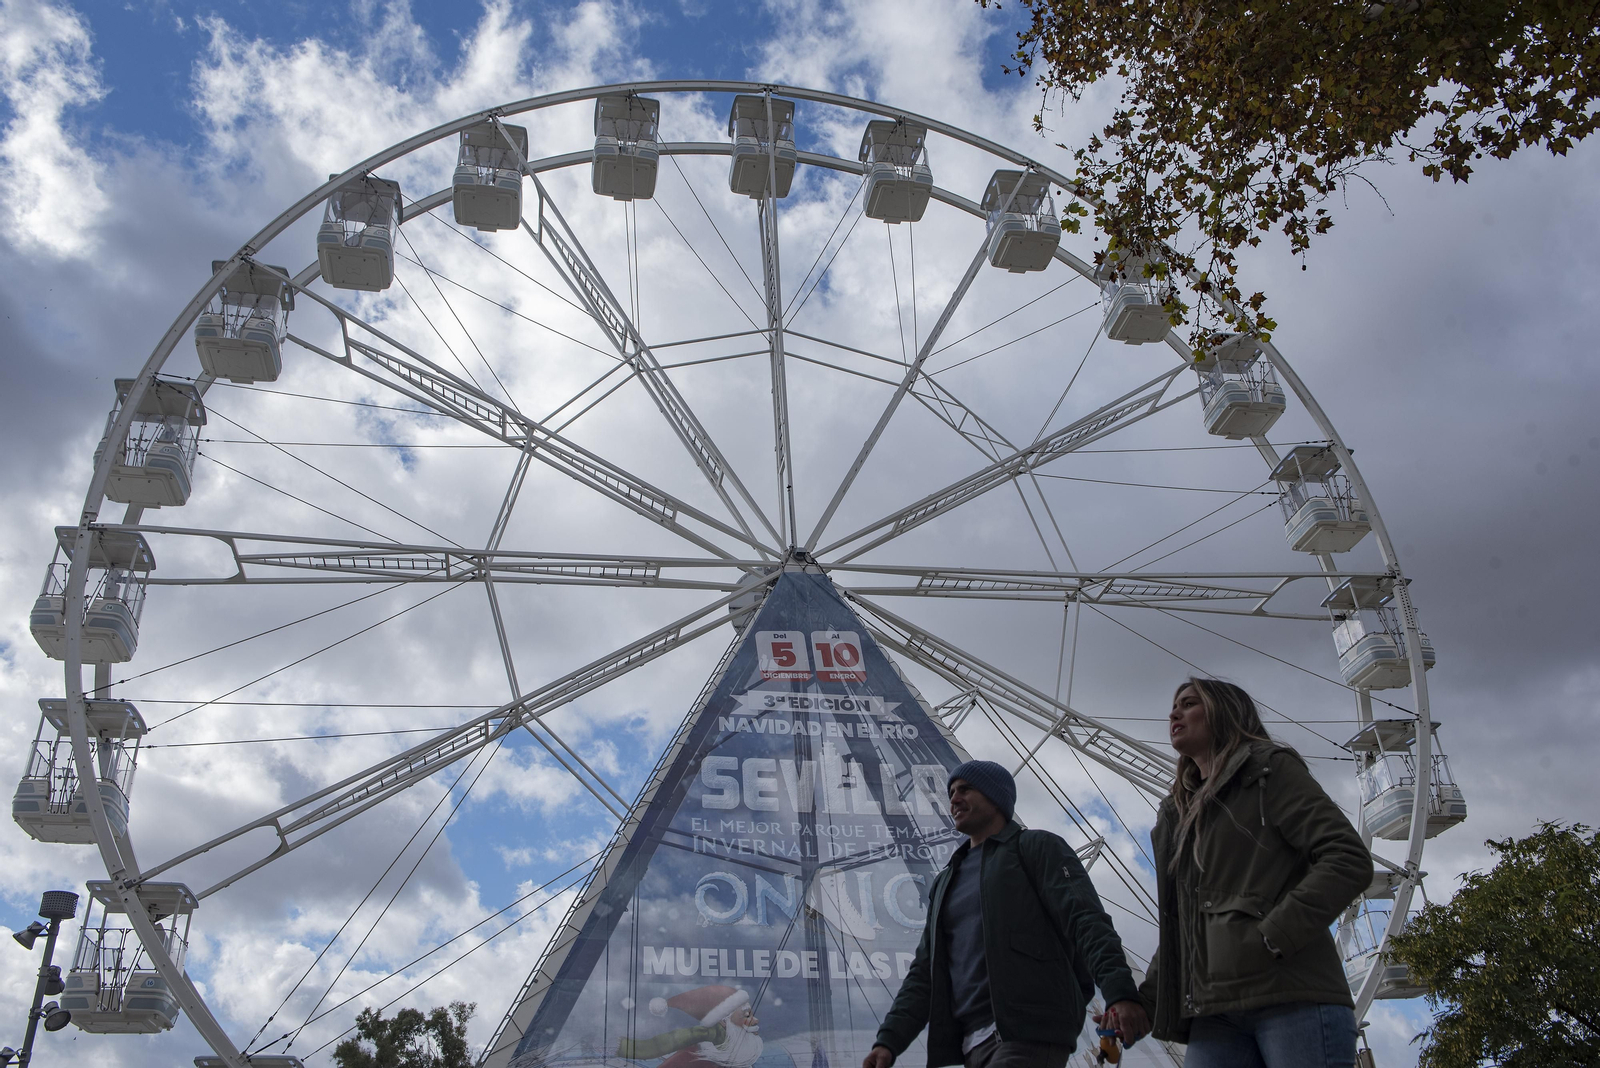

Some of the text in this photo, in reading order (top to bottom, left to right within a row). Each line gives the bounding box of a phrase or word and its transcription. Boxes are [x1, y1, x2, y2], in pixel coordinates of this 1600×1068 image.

[771, 642, 797, 667] 5
[815, 642, 860, 668] 10
[788, 696, 871, 712] EDICIÓN
[718, 716, 823, 736] NAVIDAD
[825, 721, 854, 738] EN
[856, 722, 880, 738] EL
[691, 817, 712, 832] EL
[720, 819, 784, 835] MEJOR
[790, 822, 866, 839] PARQUE
[692, 834, 818, 858] INVERNAL
[827, 841, 857, 858] DE
[643, 945, 772, 978] MUELLE
[776, 950, 820, 979] DE
[828, 951, 893, 980] LAS
